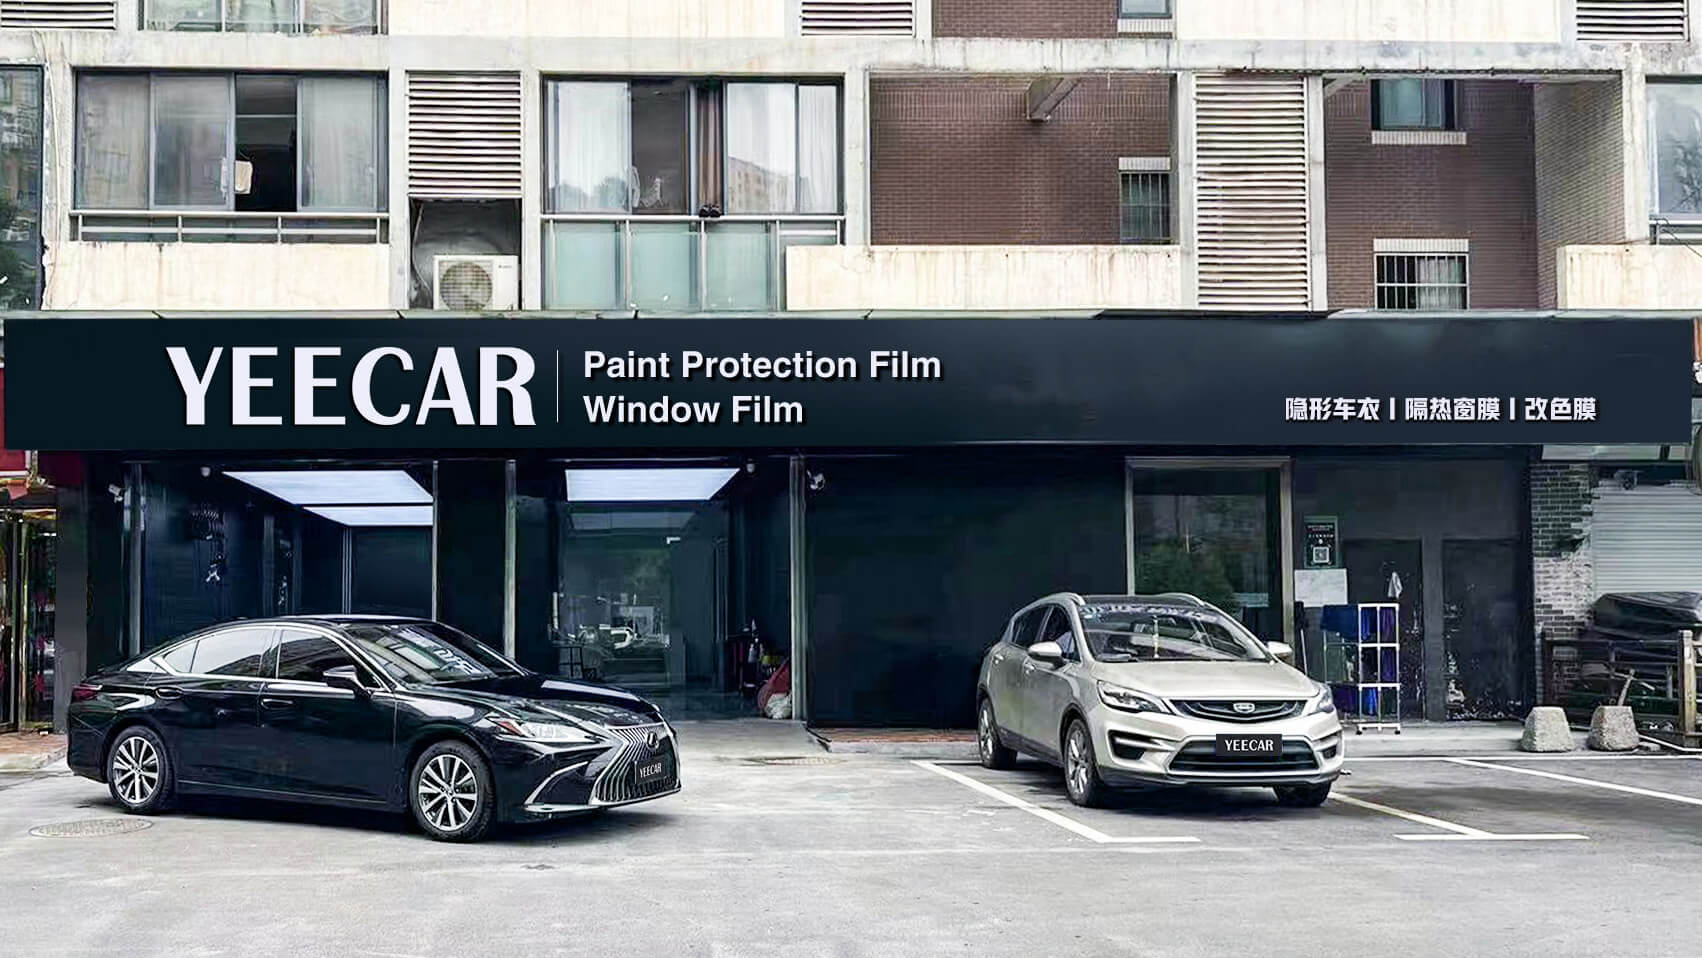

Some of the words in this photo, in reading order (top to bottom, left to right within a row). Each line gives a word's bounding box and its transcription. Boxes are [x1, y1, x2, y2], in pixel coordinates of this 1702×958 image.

[584, 351, 670, 378] Paint
[682, 351, 857, 378] Protection
[870, 351, 941, 378] Film
[166, 347, 536, 425] YEECAR
[583, 396, 720, 422] Window
[732, 396, 803, 422] Film
[1285, 397, 1380, 421] 隐形车衣
[1406, 397, 1501, 421] 隔热窗膜
[1525, 397, 1597, 421] 改色膜
[1224, 739, 1274, 752] YEECAR
[639, 763, 662, 778] YEECAR
